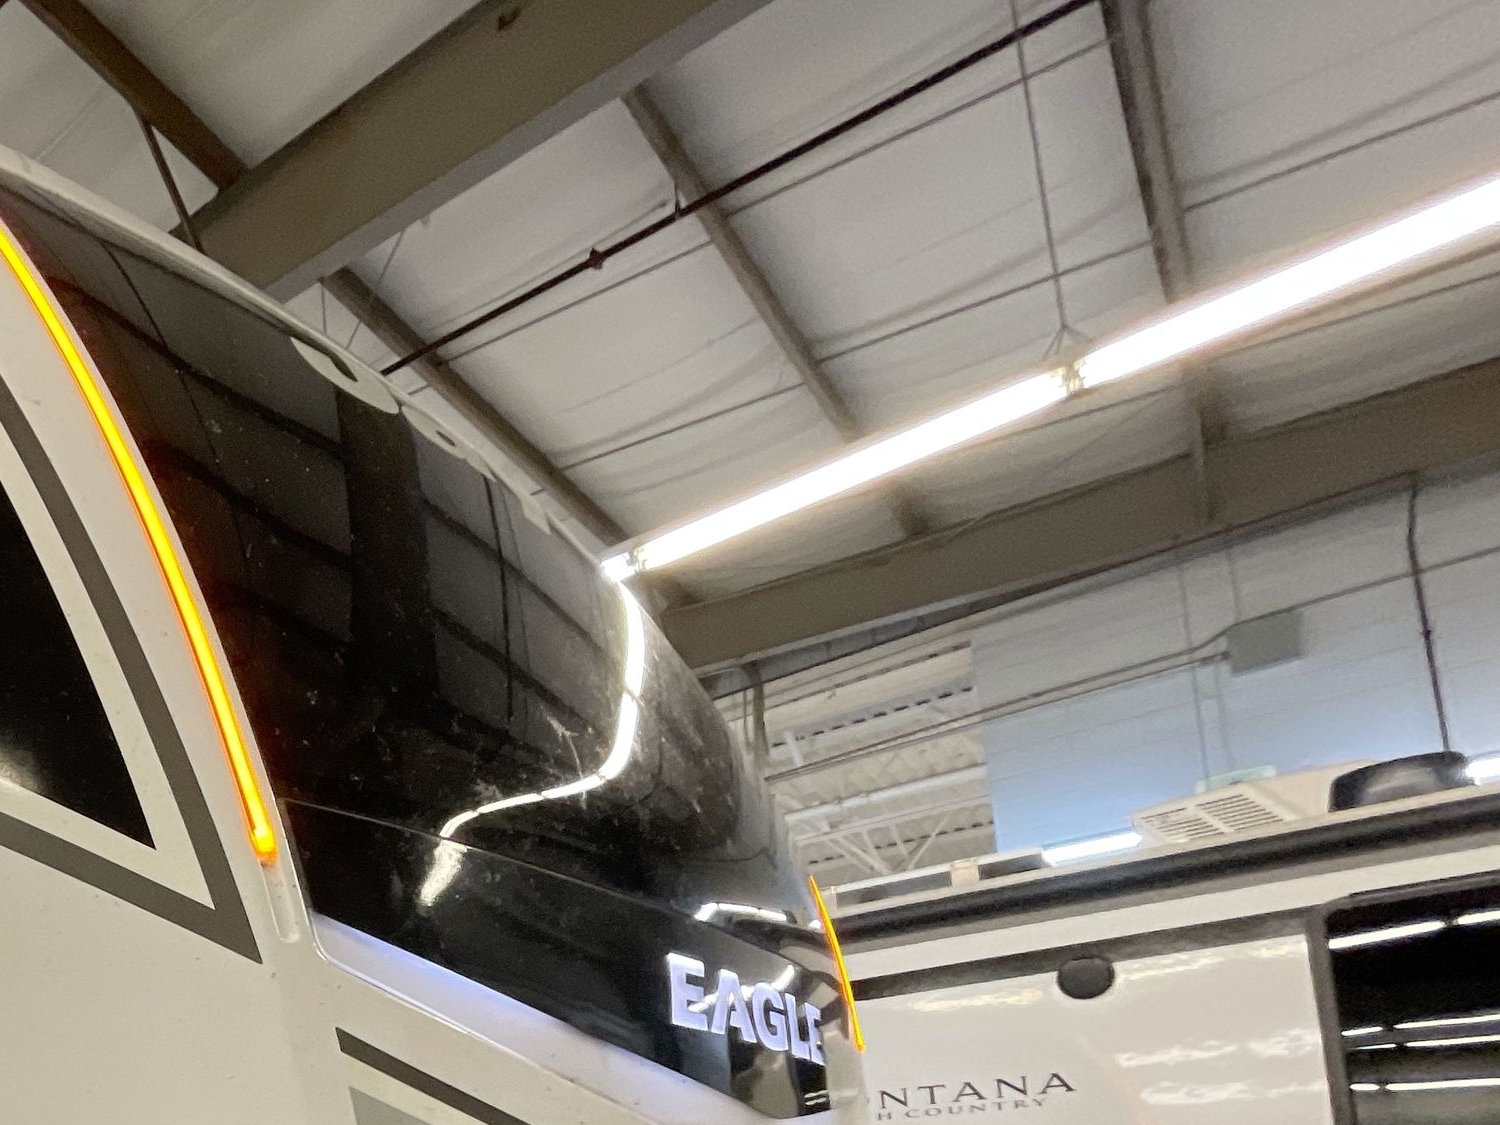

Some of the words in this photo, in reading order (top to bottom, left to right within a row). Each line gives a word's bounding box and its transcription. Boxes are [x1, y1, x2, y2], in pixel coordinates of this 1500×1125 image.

[666, 951, 827, 1067] EAGLE
[877, 1072, 1078, 1110] NTANA
[905, 1096, 1048, 1120] COUNTRY
